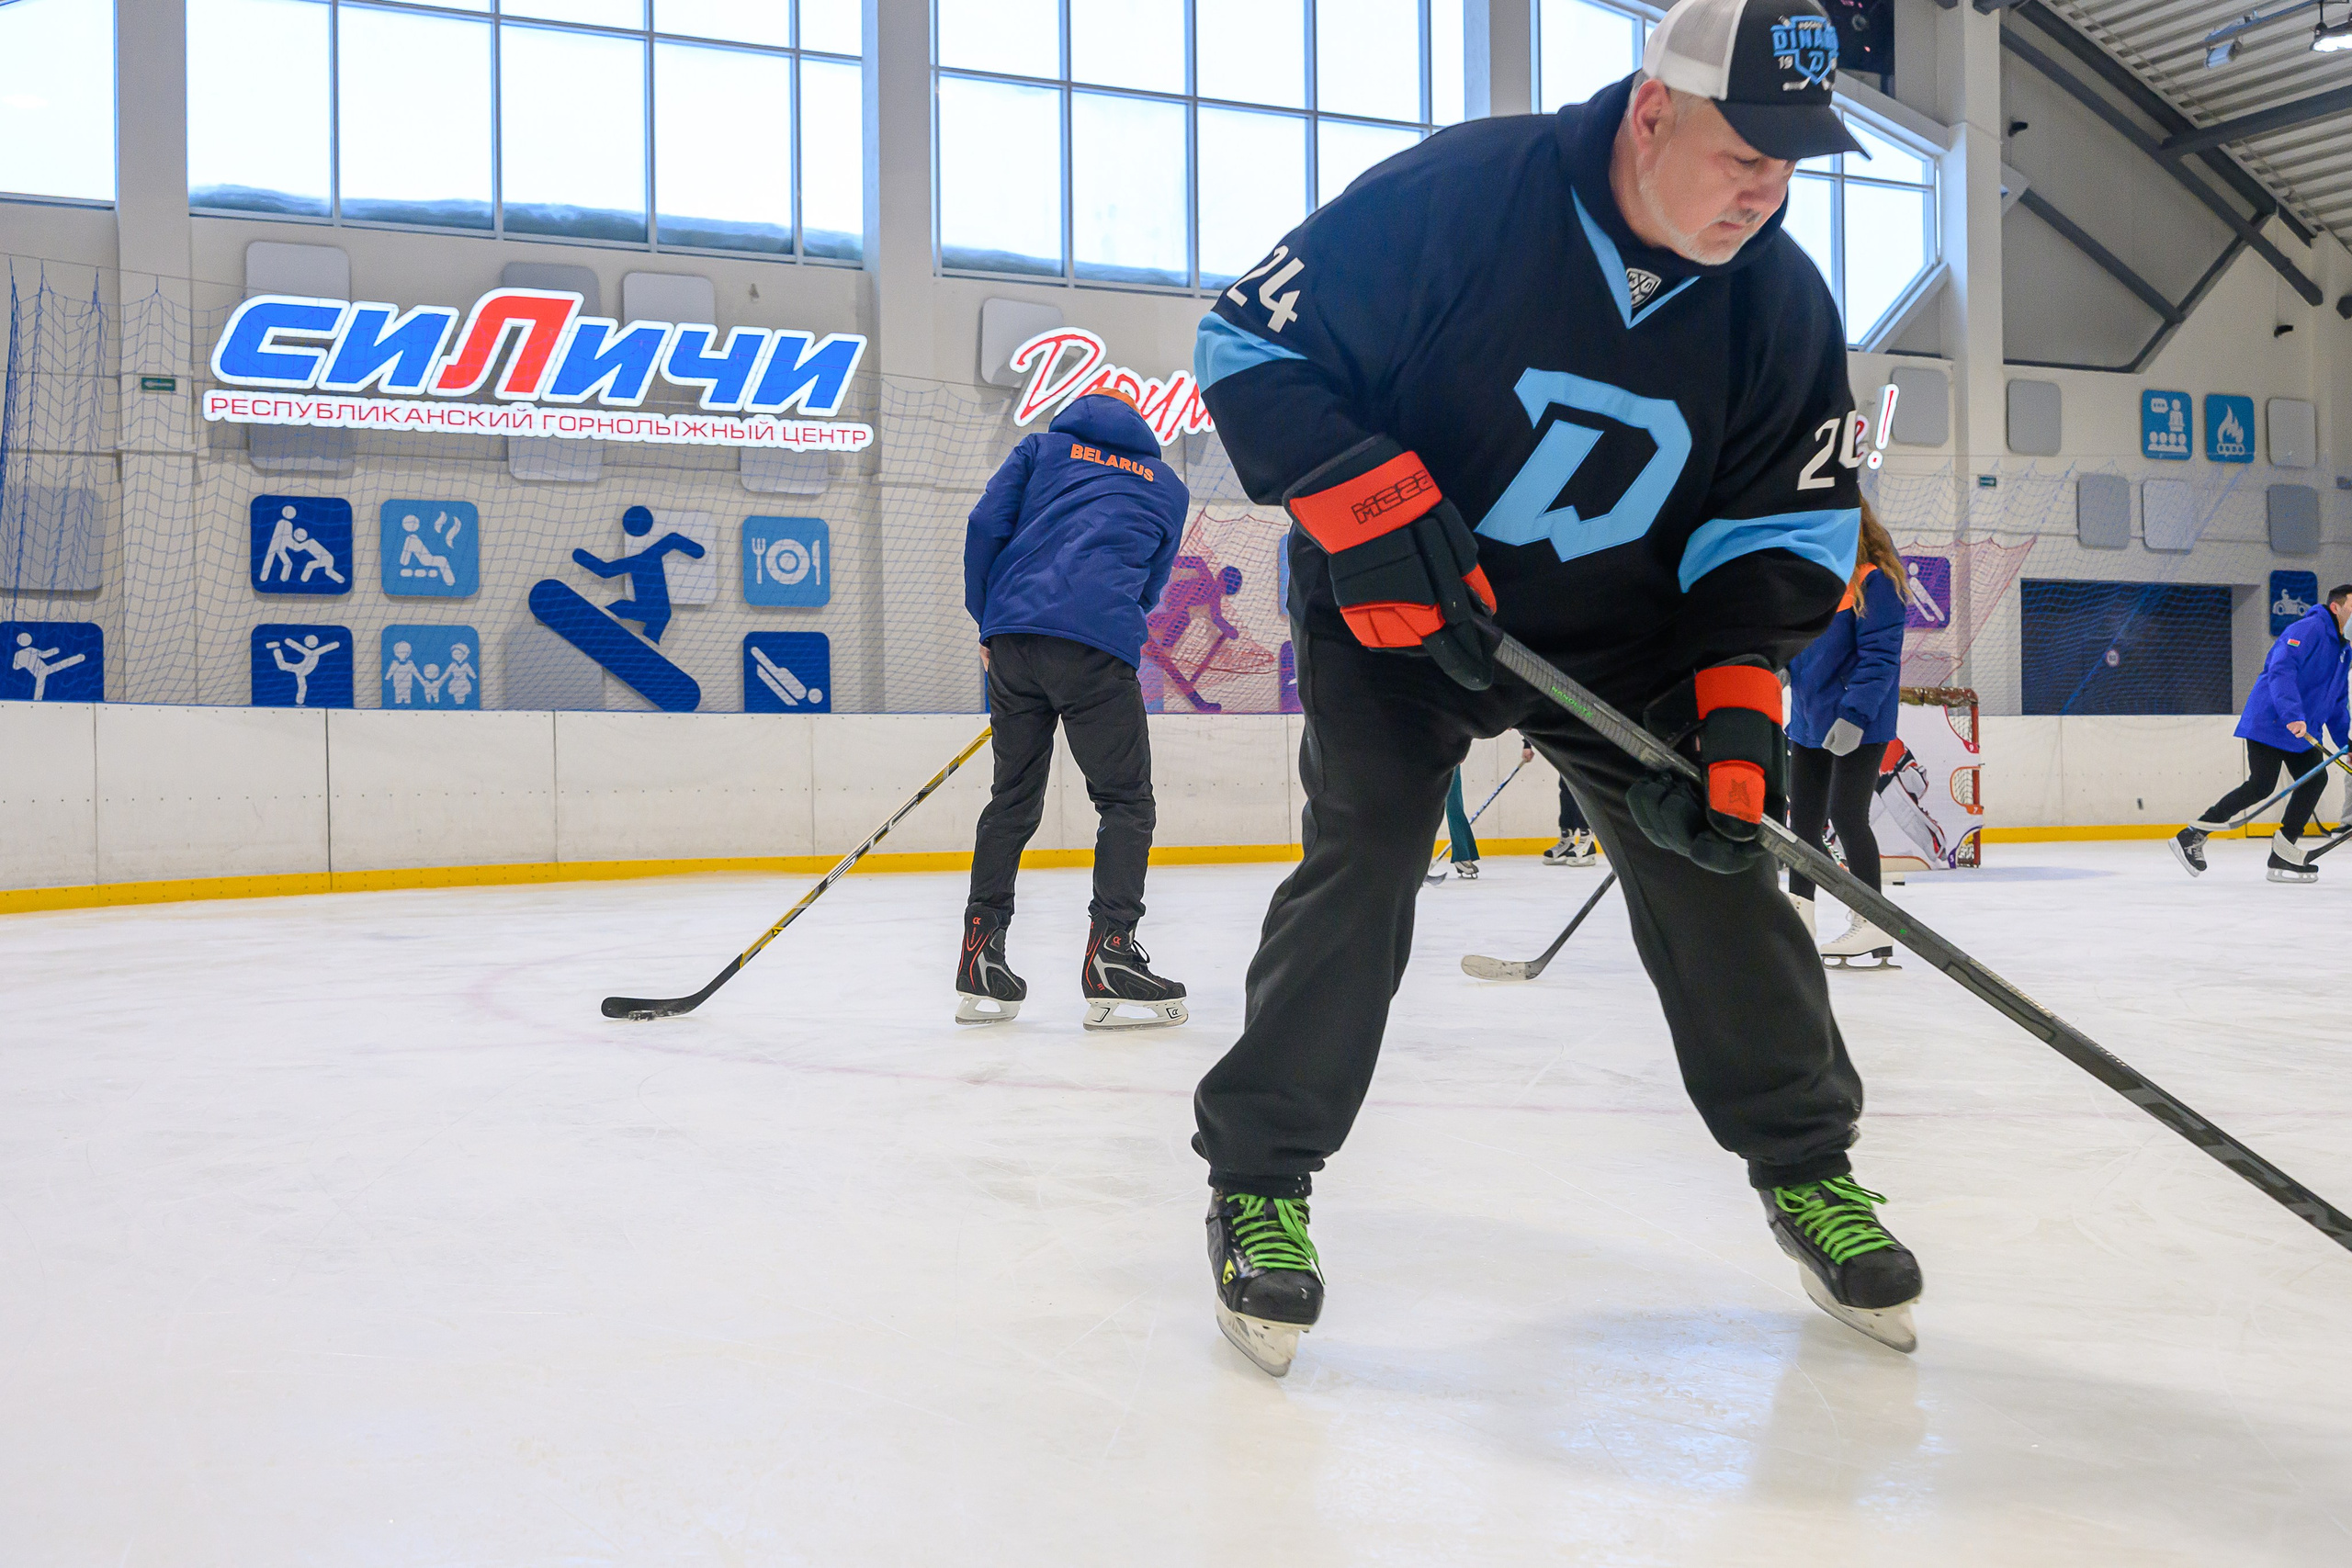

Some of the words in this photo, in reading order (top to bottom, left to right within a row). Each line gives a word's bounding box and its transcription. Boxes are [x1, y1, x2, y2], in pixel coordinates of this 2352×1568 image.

[1226, 244, 1305, 333] 24
[210, 396, 534, 432] РЕСПУБЛИКАНСКИЙ
[543, 413, 775, 443] ГОРНОЛЫЖНЫЙ
[783, 426, 867, 446] ЦЕНТР
[1069, 444, 1154, 482] BELARUS
